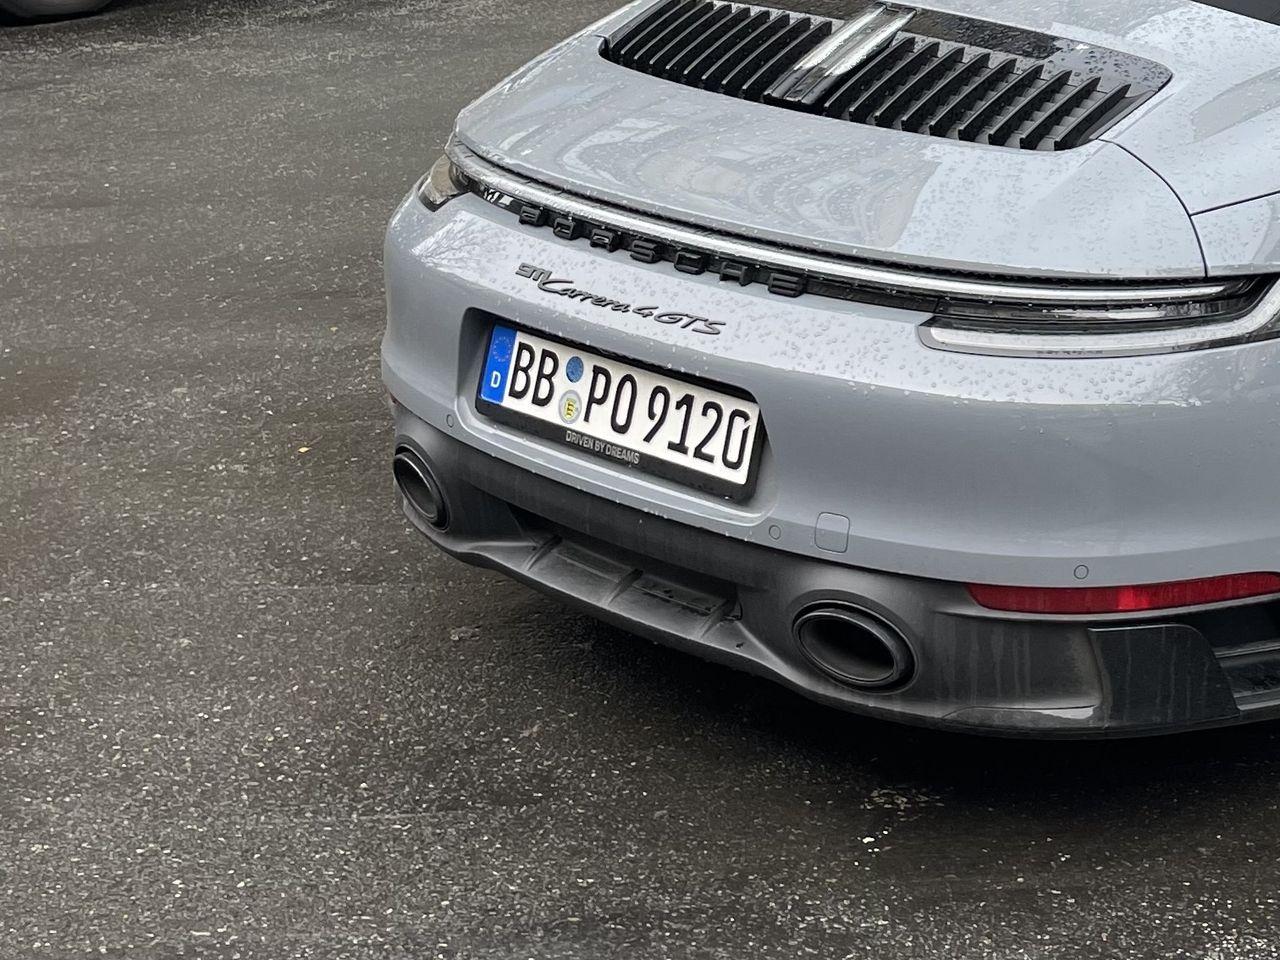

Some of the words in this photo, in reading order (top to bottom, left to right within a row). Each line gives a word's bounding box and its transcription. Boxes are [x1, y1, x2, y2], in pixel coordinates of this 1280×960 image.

[518, 205, 808, 298] PORSCHE
[538, 278, 631, 313] Carrera
[654, 311, 726, 335] GTS
[490, 370, 501, 389] D
[508, 341, 559, 407] BB
[583, 364, 638, 435] PO
[643, 384, 752, 470] 9120
[565, 430, 595, 450] DRIVEN
[594, 439, 607, 453] BY
[605, 444, 640, 464] DREAMS
